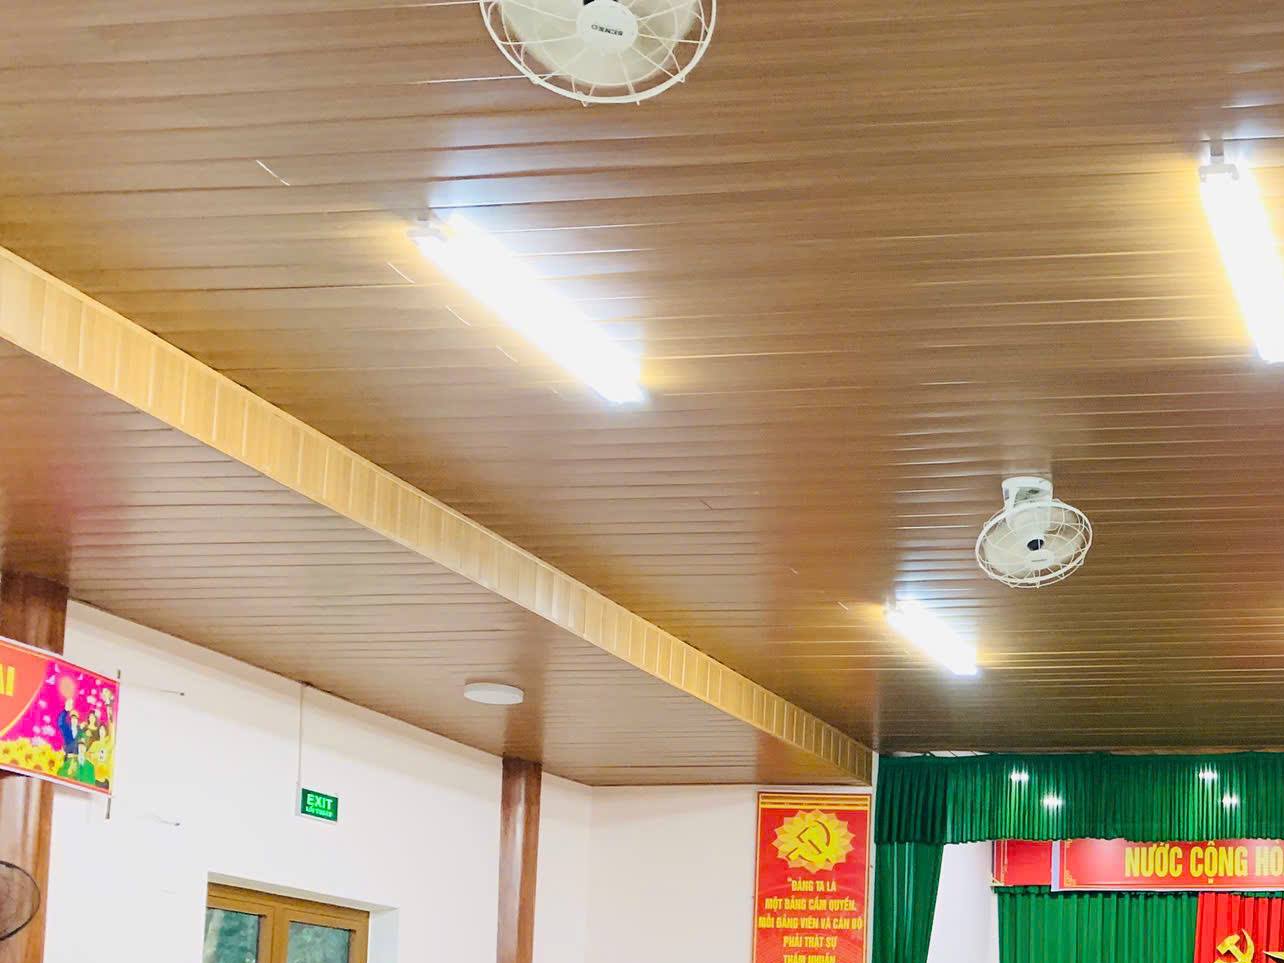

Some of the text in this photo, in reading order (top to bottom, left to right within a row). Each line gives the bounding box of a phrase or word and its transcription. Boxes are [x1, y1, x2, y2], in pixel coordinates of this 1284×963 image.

[307, 793, 333, 810] EXIT
[1125, 842, 1183, 877] NƯỚC
[1189, 840, 1249, 884] CỘNG
